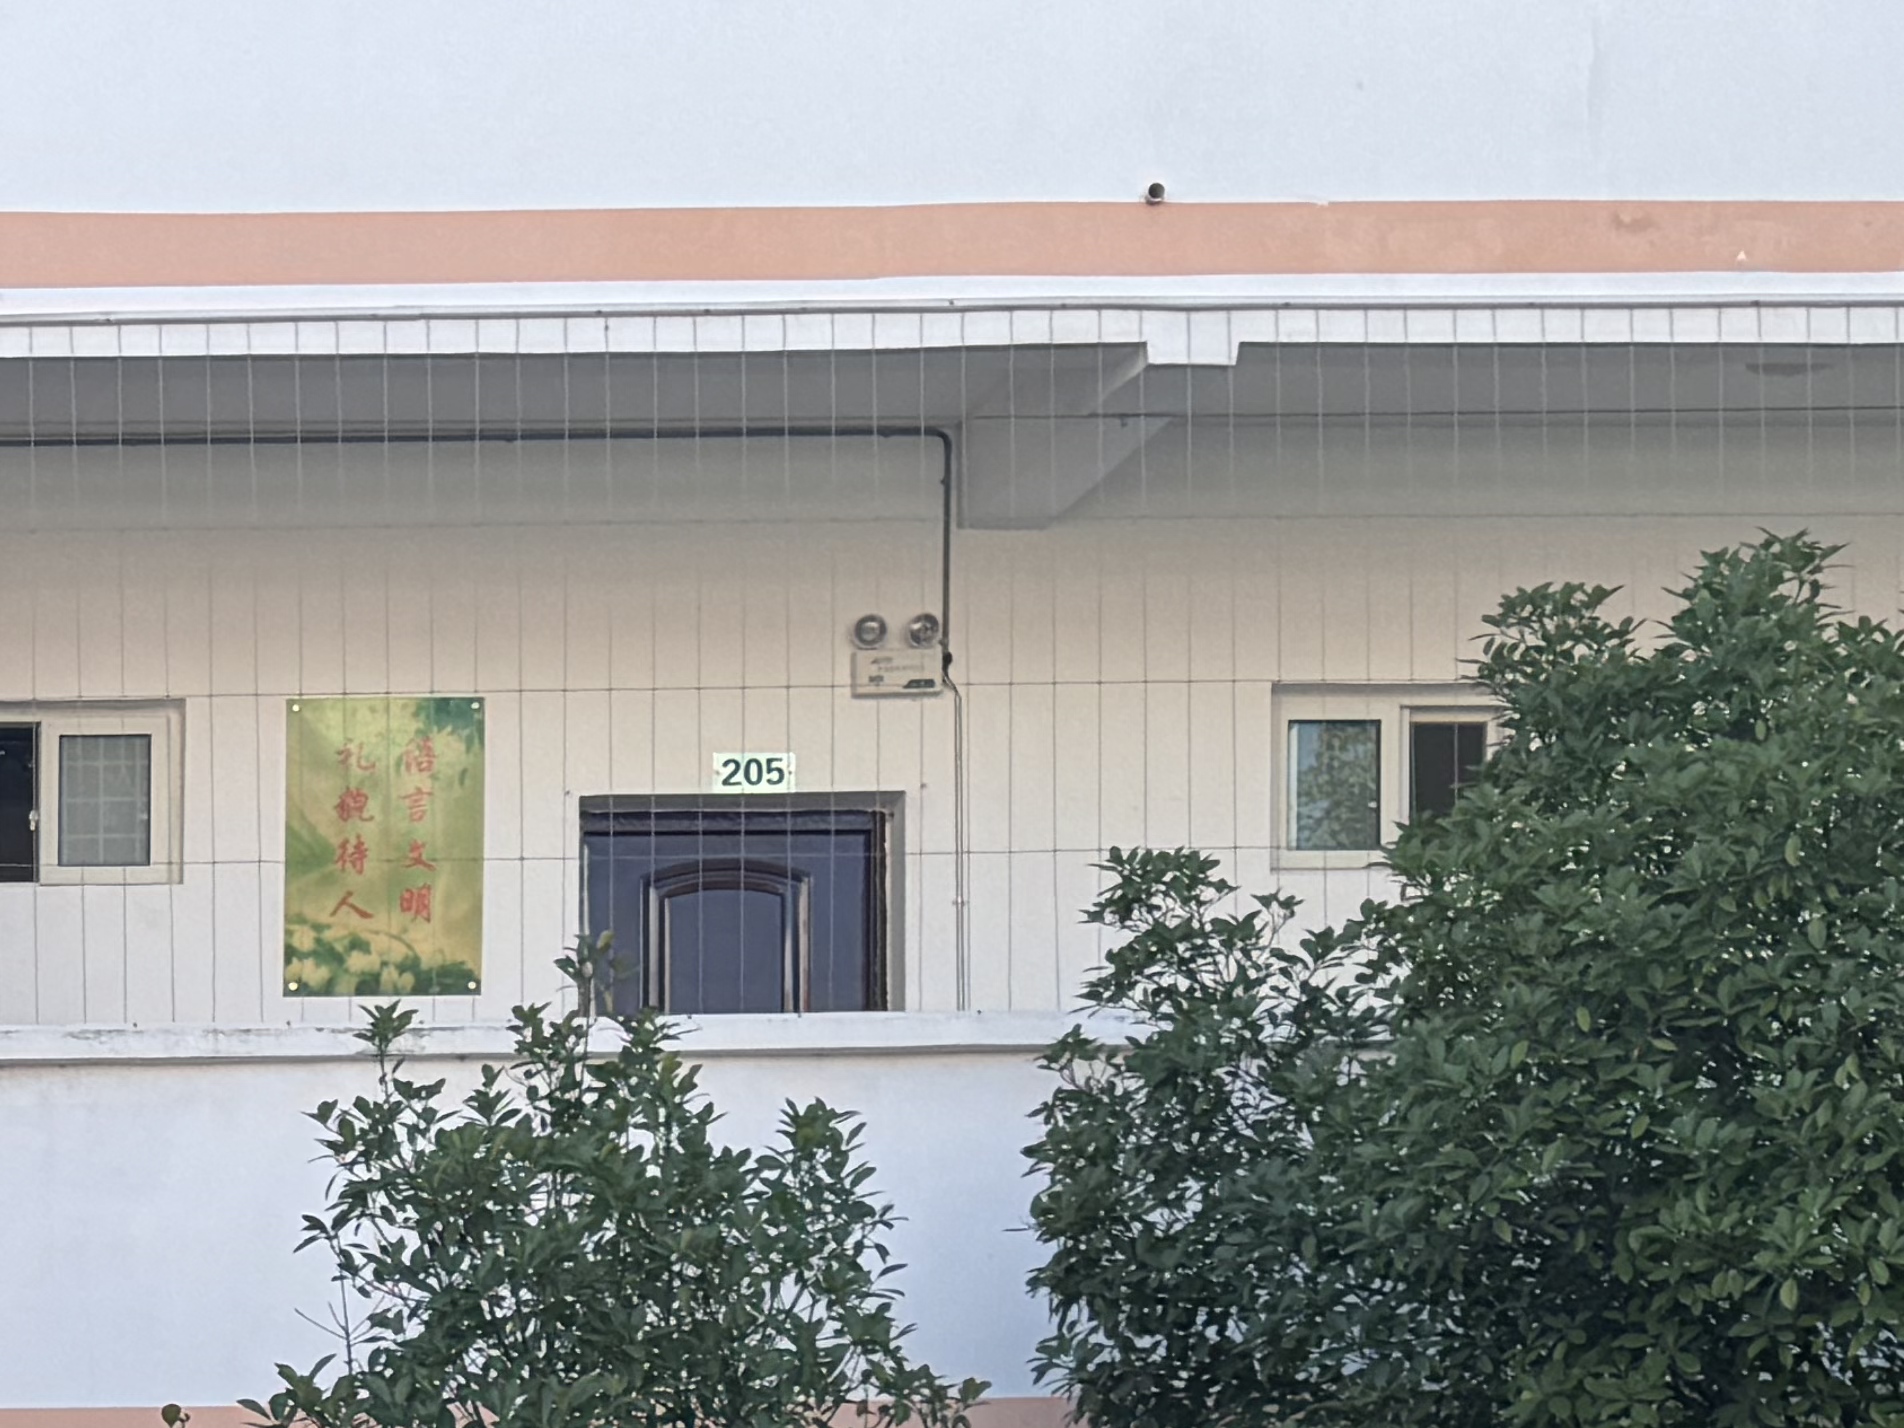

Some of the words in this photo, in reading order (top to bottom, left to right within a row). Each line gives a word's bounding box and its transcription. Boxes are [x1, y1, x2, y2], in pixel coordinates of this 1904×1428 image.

[330, 738, 376, 919] 礼貌待人
[399, 737, 436, 923] 语言文明
[721, 757, 785, 787] 205
